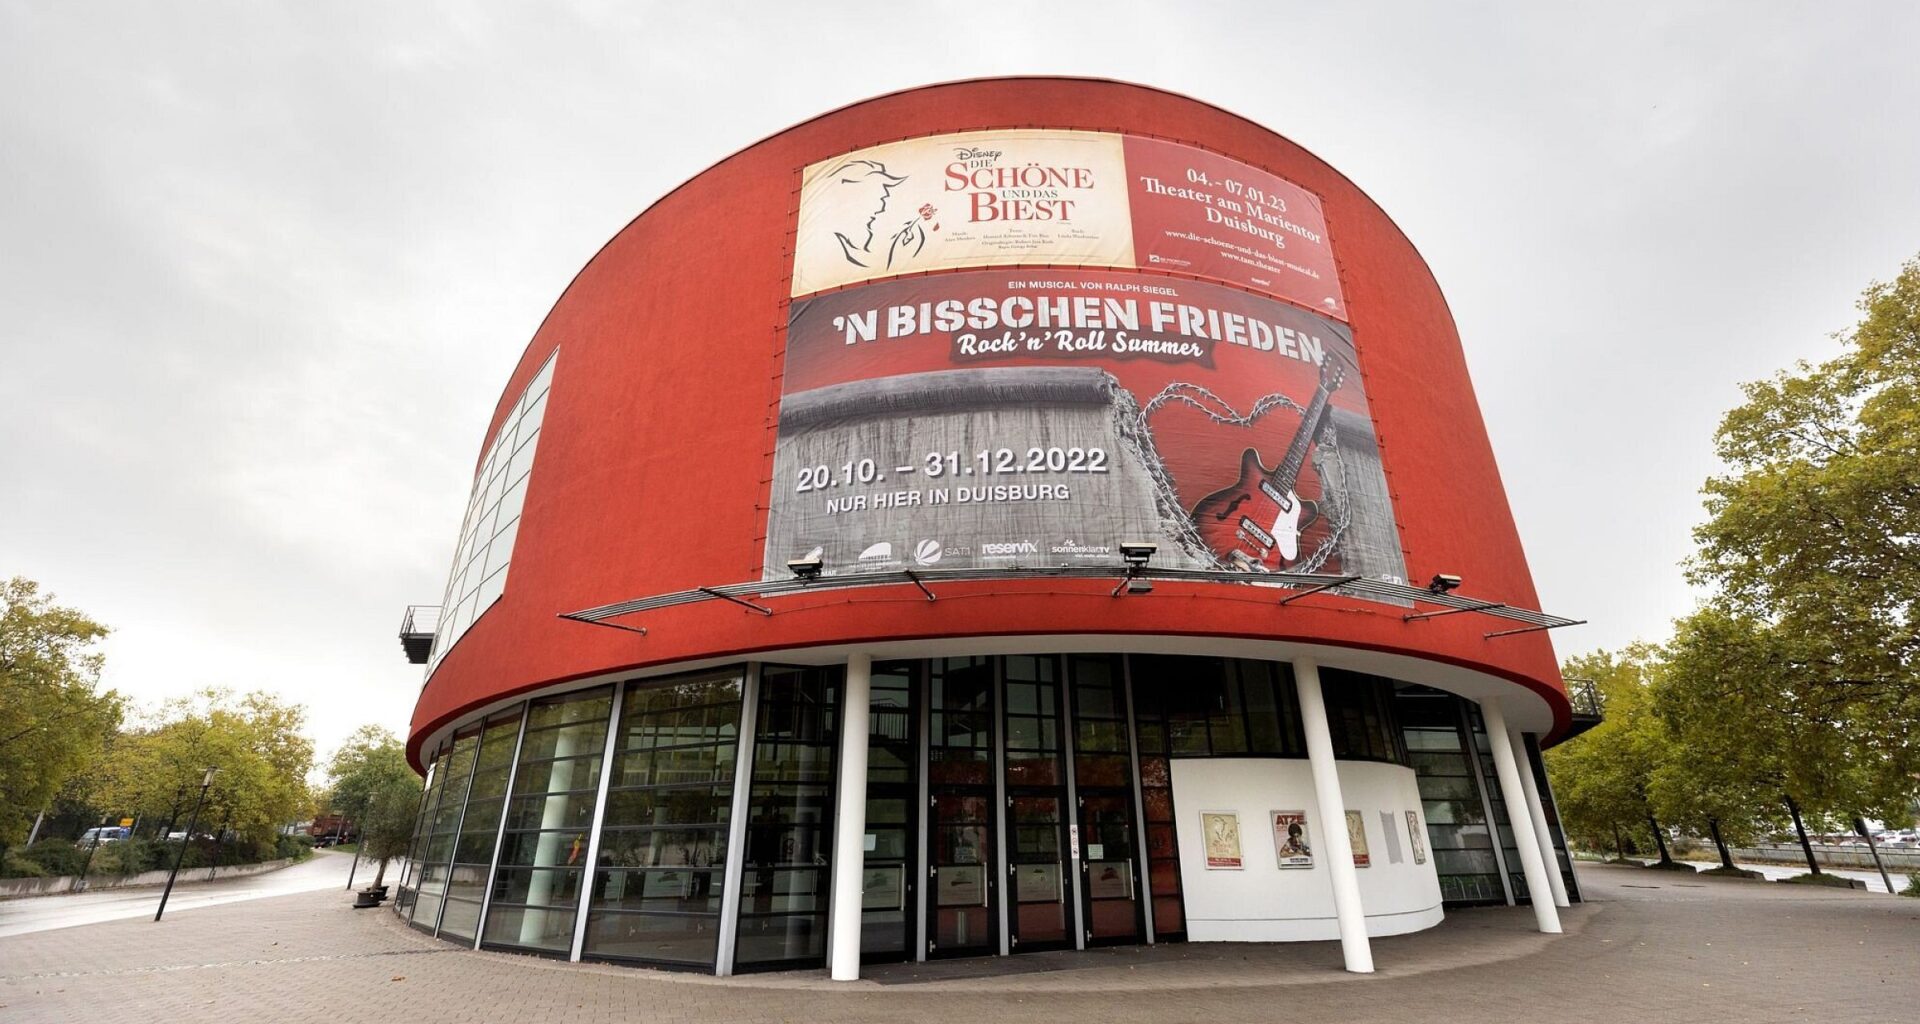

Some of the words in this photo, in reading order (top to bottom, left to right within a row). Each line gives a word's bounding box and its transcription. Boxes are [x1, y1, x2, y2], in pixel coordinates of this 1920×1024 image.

[945, 162, 1094, 192] SCHÖNE
[970, 159, 992, 169] DIE
[968, 191, 1075, 223] BIEST
[1002, 190, 1030, 199] UND
[1033, 190, 1058, 198] DAS
[1140, 176, 1212, 204] Theater
[1217, 196, 1241, 212] am
[1246, 201, 1321, 244] Marientor
[1205, 207, 1285, 249] Duisburg
[1220, 251, 1281, 274] www.tam.theater
[1008, 281, 1026, 289] EIN
[1029, 281, 1077, 289] MUSICAL
[1080, 282, 1102, 290] VON
[1105, 283, 1140, 292] RALPH
[1143, 286, 1179, 297] SIEGEL
[887, 296, 1139, 338] BISSCHEN
[1149, 301, 1325, 366] FRIEDEN
[1112, 331, 1203, 357] Summer
[796, 458, 884, 492] 20.10.
[925, 447, 1107, 477] 31.12.2022
[826, 495, 867, 514] NUR
[874, 491, 921, 508] HIER
[929, 488, 949, 505] IN
[957, 484, 1070, 503] DUISBURG
[982, 540, 1039, 559] reservix
